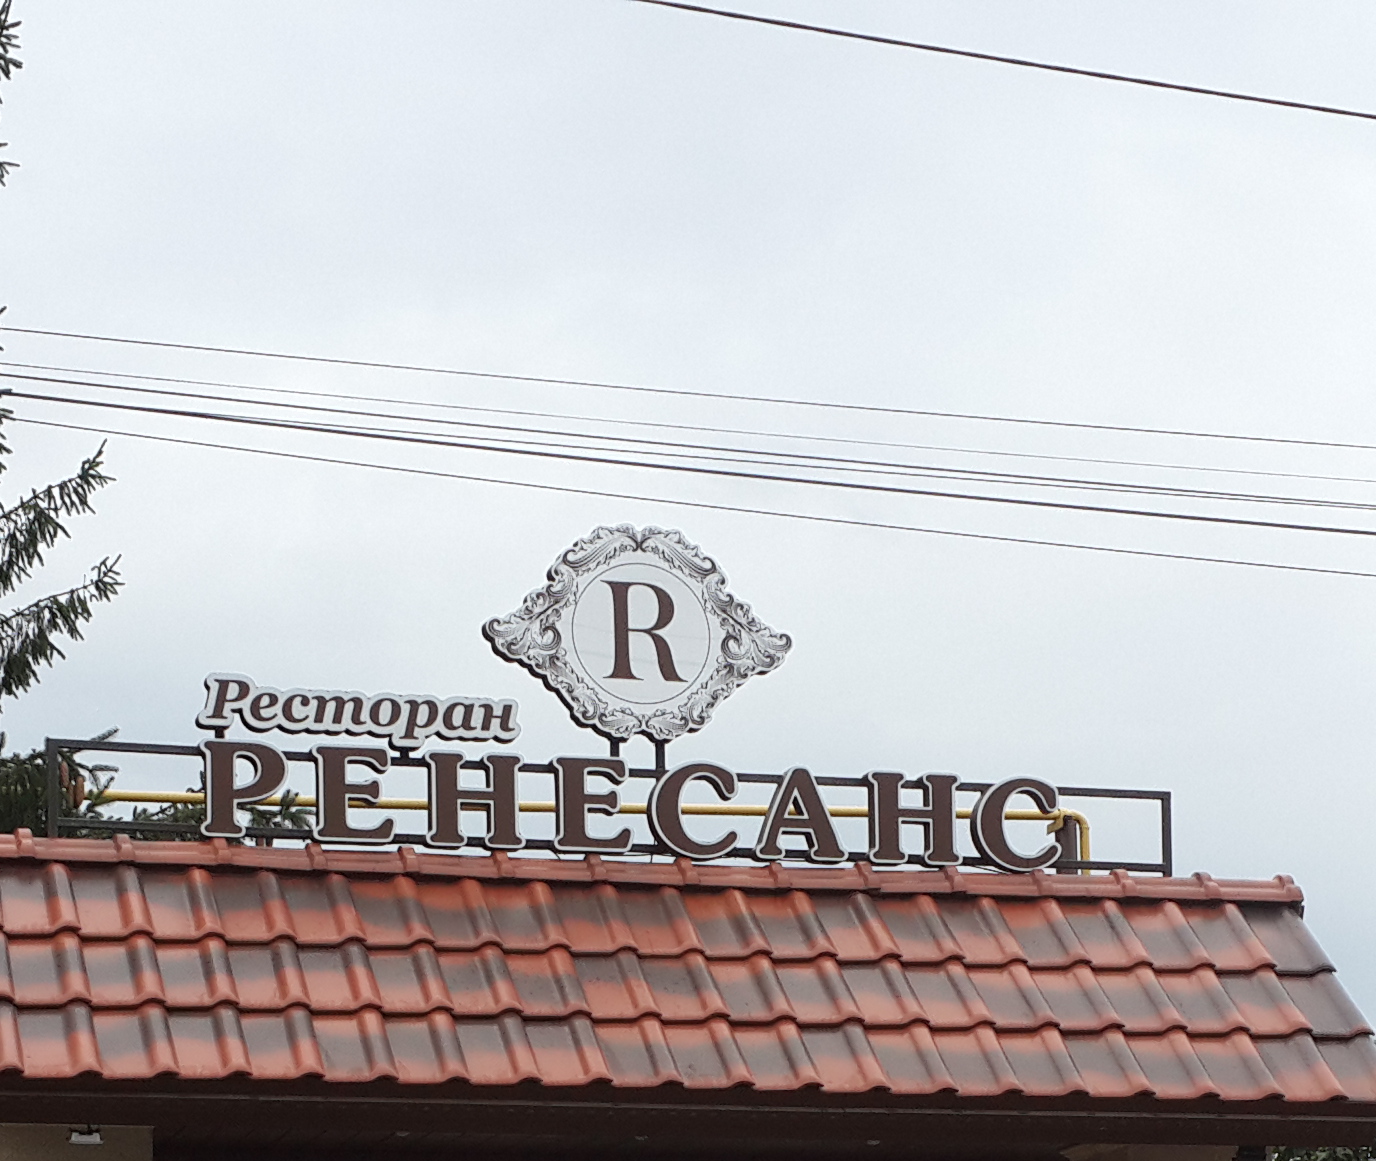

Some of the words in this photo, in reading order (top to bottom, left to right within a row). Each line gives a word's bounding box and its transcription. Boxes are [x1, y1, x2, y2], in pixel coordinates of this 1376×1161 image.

[600, 580, 688, 682] R
[209, 677, 516, 741] Ресторан
[201, 740, 1062, 872] РЕНЕСАНС
